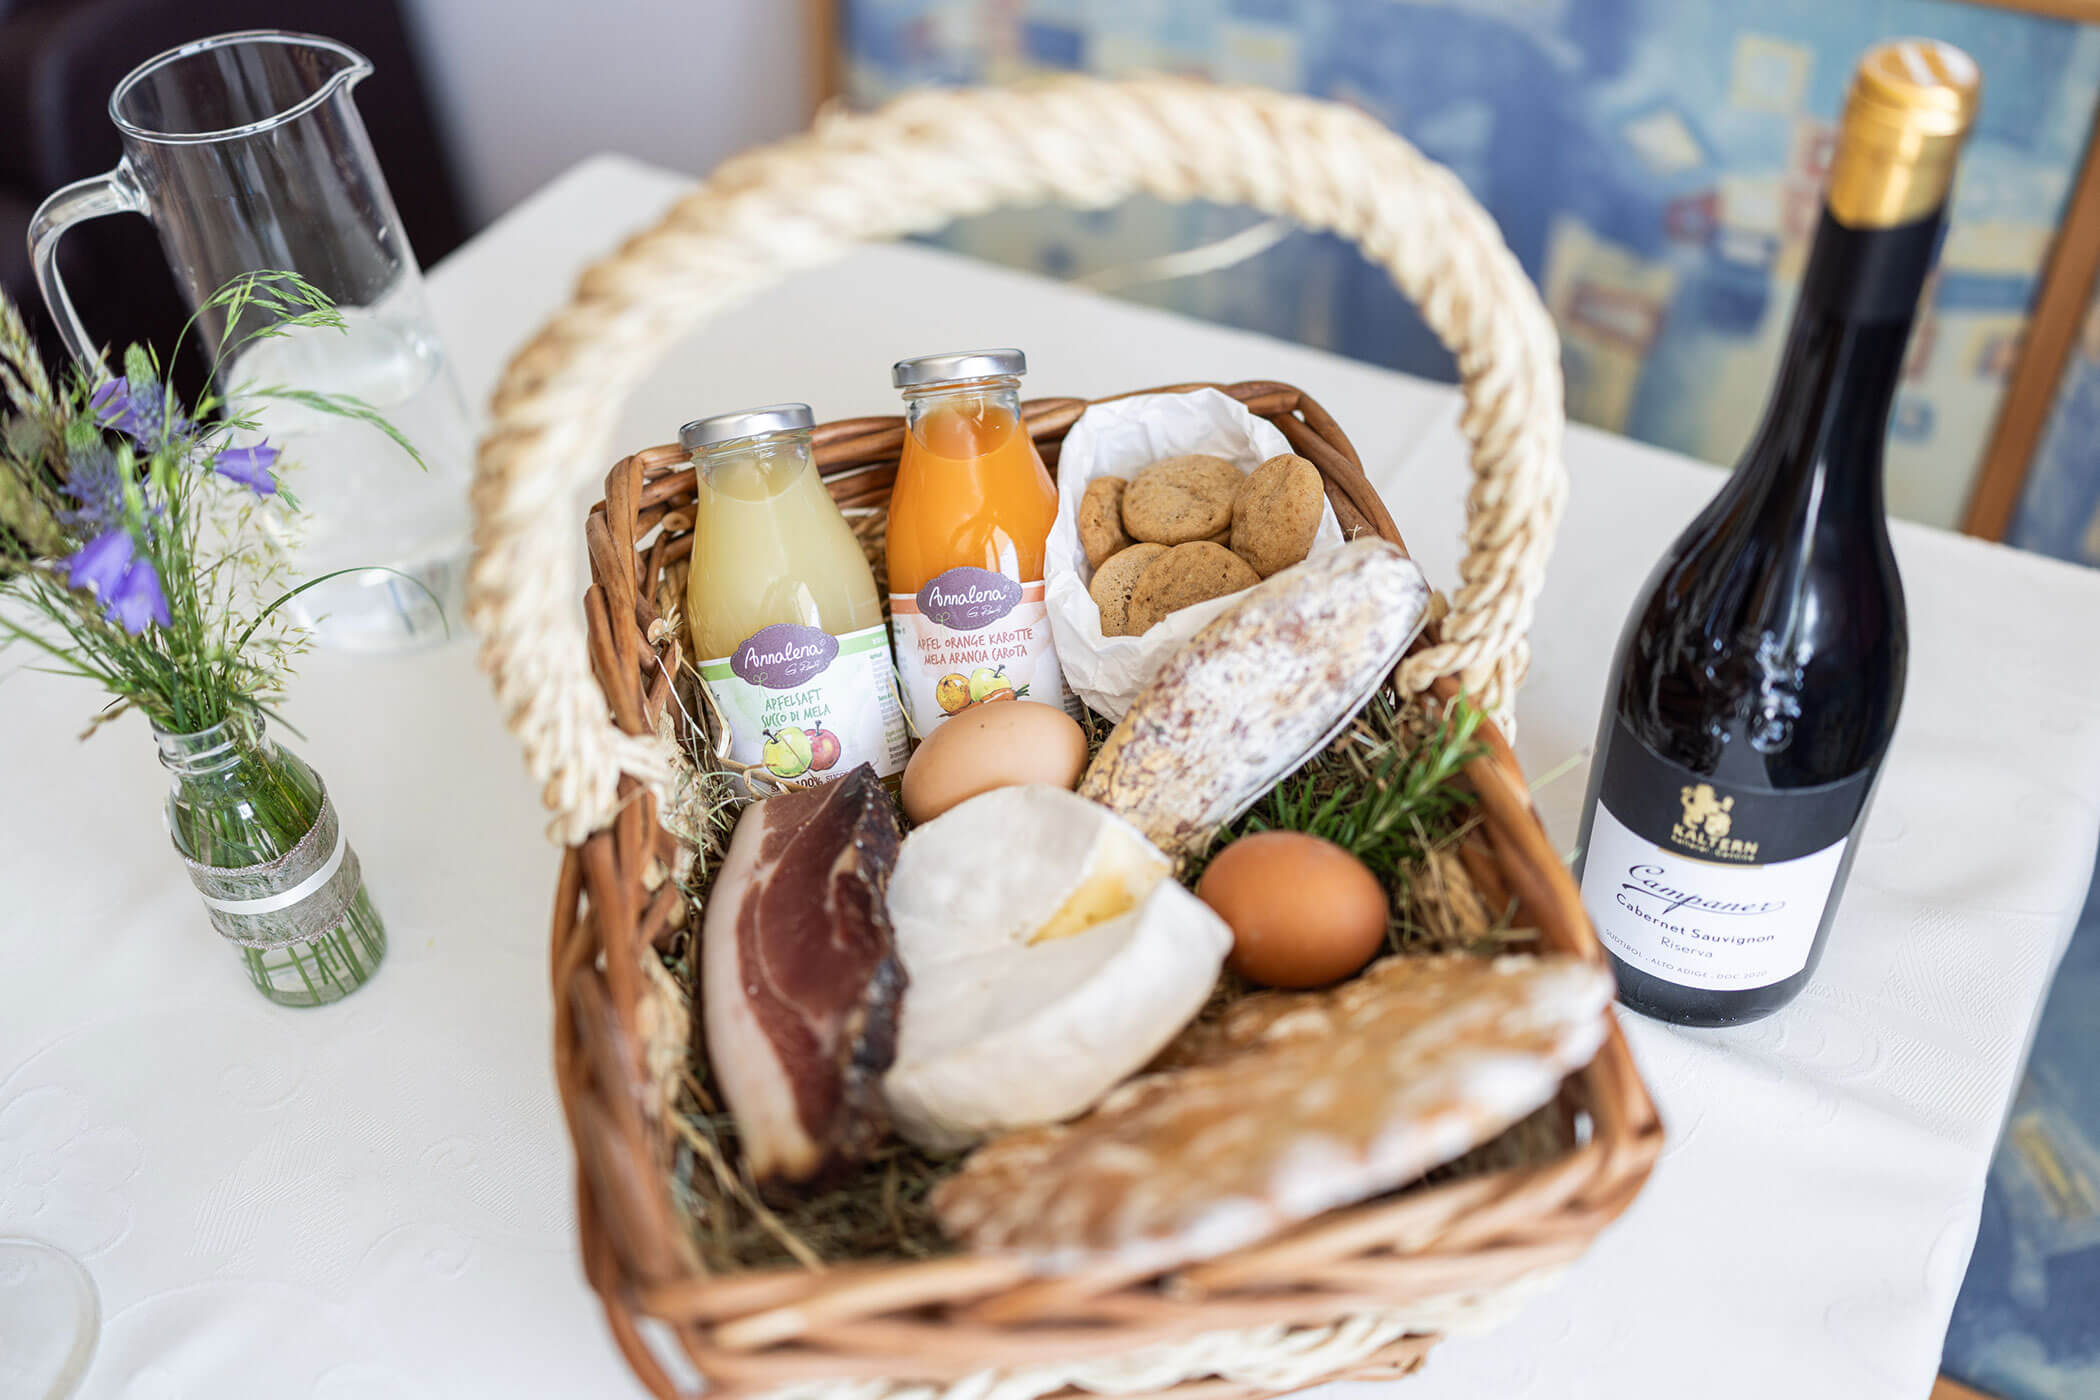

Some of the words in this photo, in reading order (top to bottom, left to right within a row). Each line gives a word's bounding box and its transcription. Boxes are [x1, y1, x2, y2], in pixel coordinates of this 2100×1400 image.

[928, 585, 1007, 608] Annalena
[917, 637, 942, 651] APFEL
[944, 634, 985, 649] ORANGE
[989, 627, 1033, 645] KAROTTE
[744, 642, 824, 669] Annalena
[924, 653, 947, 666] MELA
[949, 650, 989, 665] ARANCIA
[991, 645, 1028, 662] CAROTA
[765, 687, 823, 713] APFELSAFT
[760, 713, 787, 728] SUCCO
[790, 711, 800, 722] DI
[803, 703, 832, 721] MELA
[1672, 823, 1759, 856] KALTERN
[1616, 892, 1686, 936] Cabernet
[1691, 928, 1775, 946] Sauvignon
[1660, 935, 1713, 959] Riserva
[1650, 957, 1675, 970] ALTO
[1677, 967, 1708, 978] ADIGE
